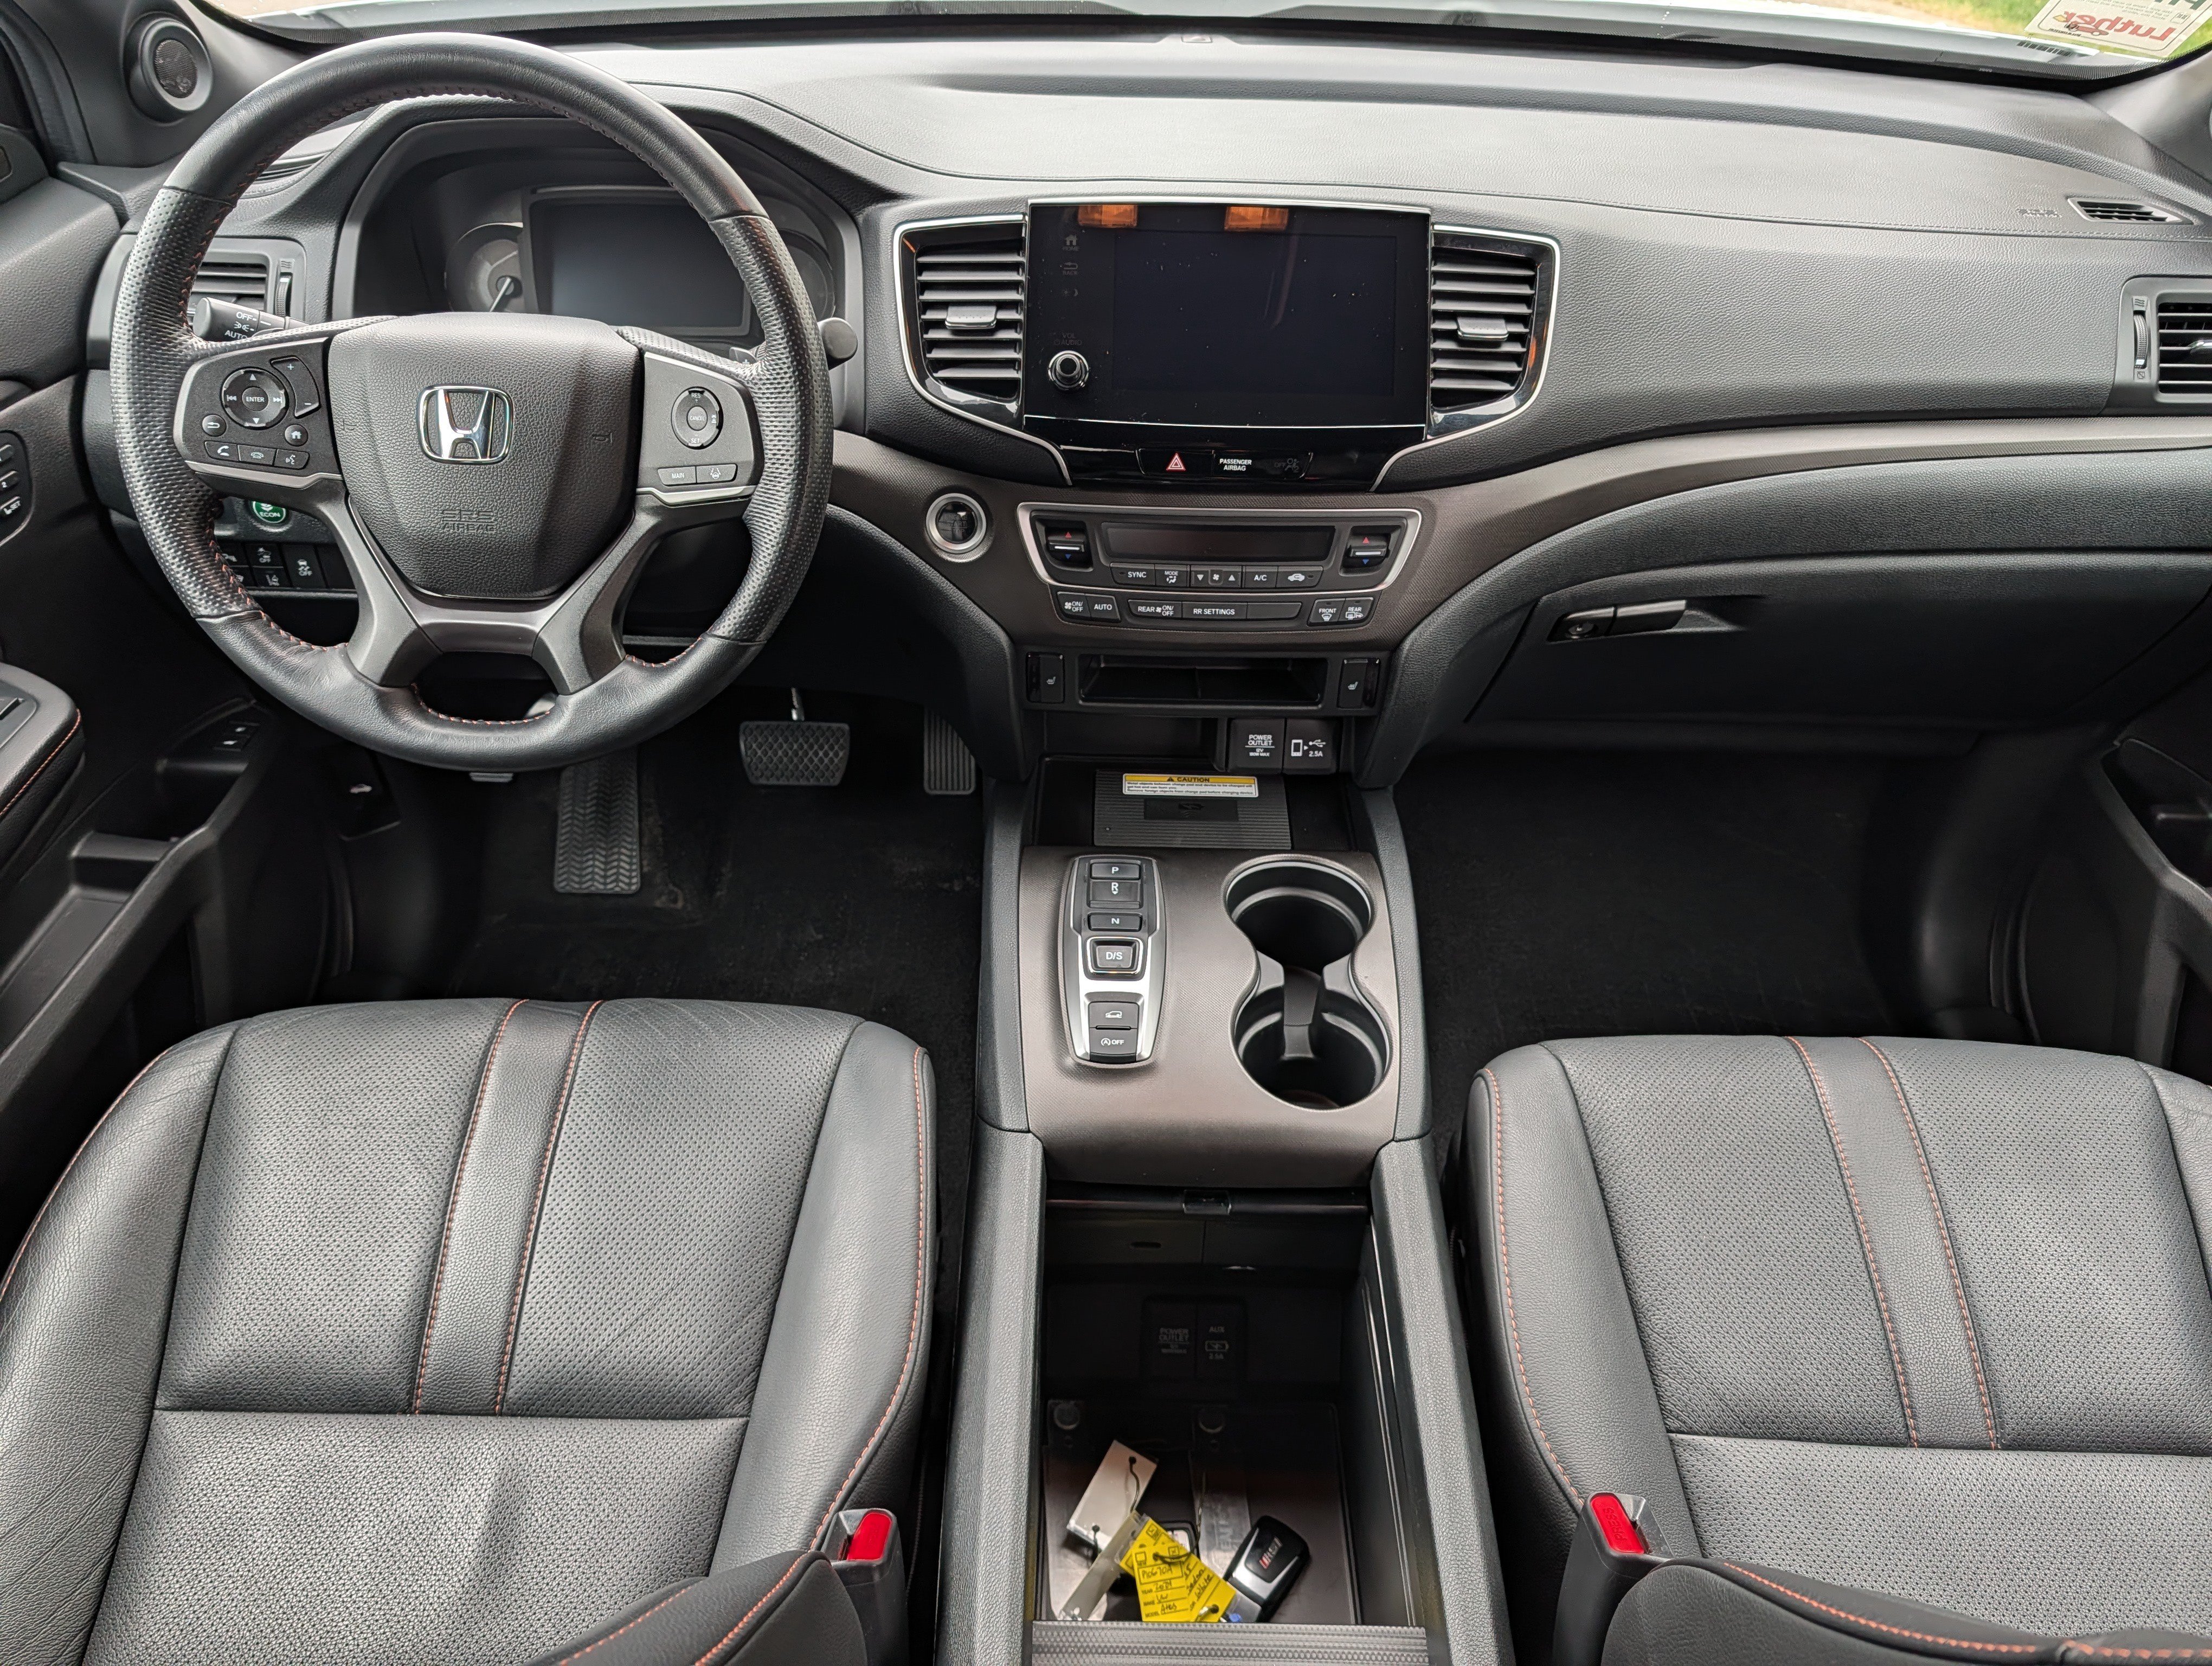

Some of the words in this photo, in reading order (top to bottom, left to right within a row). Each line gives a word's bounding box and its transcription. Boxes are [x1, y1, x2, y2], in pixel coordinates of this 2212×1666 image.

[236, 312, 252, 321] OFF
[224, 330, 247, 341] AUTO
[442, 509, 493, 521] SRS
[1111, 882, 1118, 891] R
[1105, 952, 1123, 960] D/S
